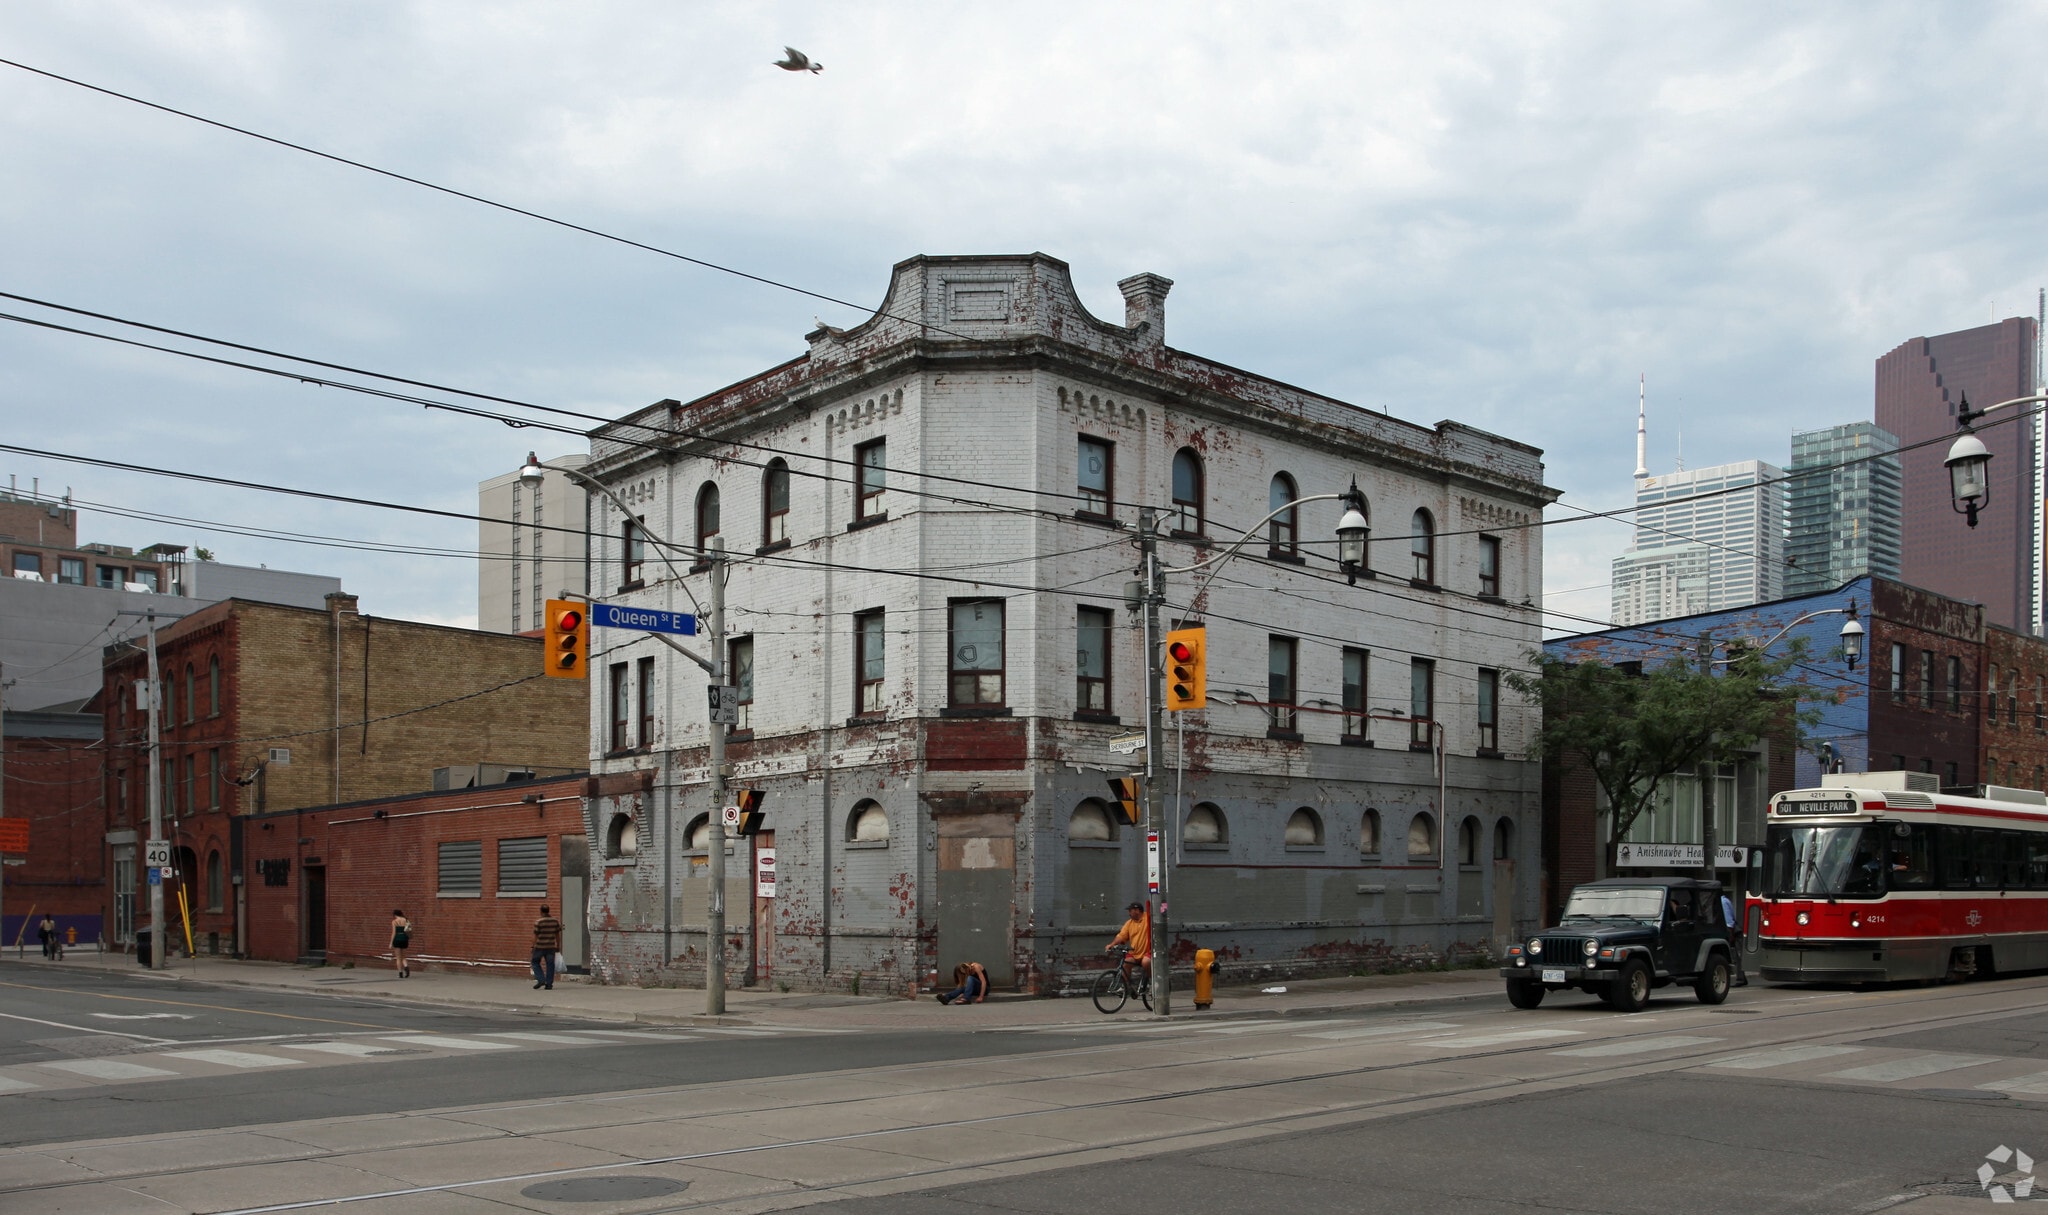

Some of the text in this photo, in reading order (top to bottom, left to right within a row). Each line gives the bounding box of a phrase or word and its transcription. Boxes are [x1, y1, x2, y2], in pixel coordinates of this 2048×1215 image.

[609, 607, 681, 629] Queen St E
[1780, 801, 1849, 813] 501 NEVILLE PARK
[148, 850, 168, 862] 40
[1636, 846, 1682, 858] Anishnawbe
